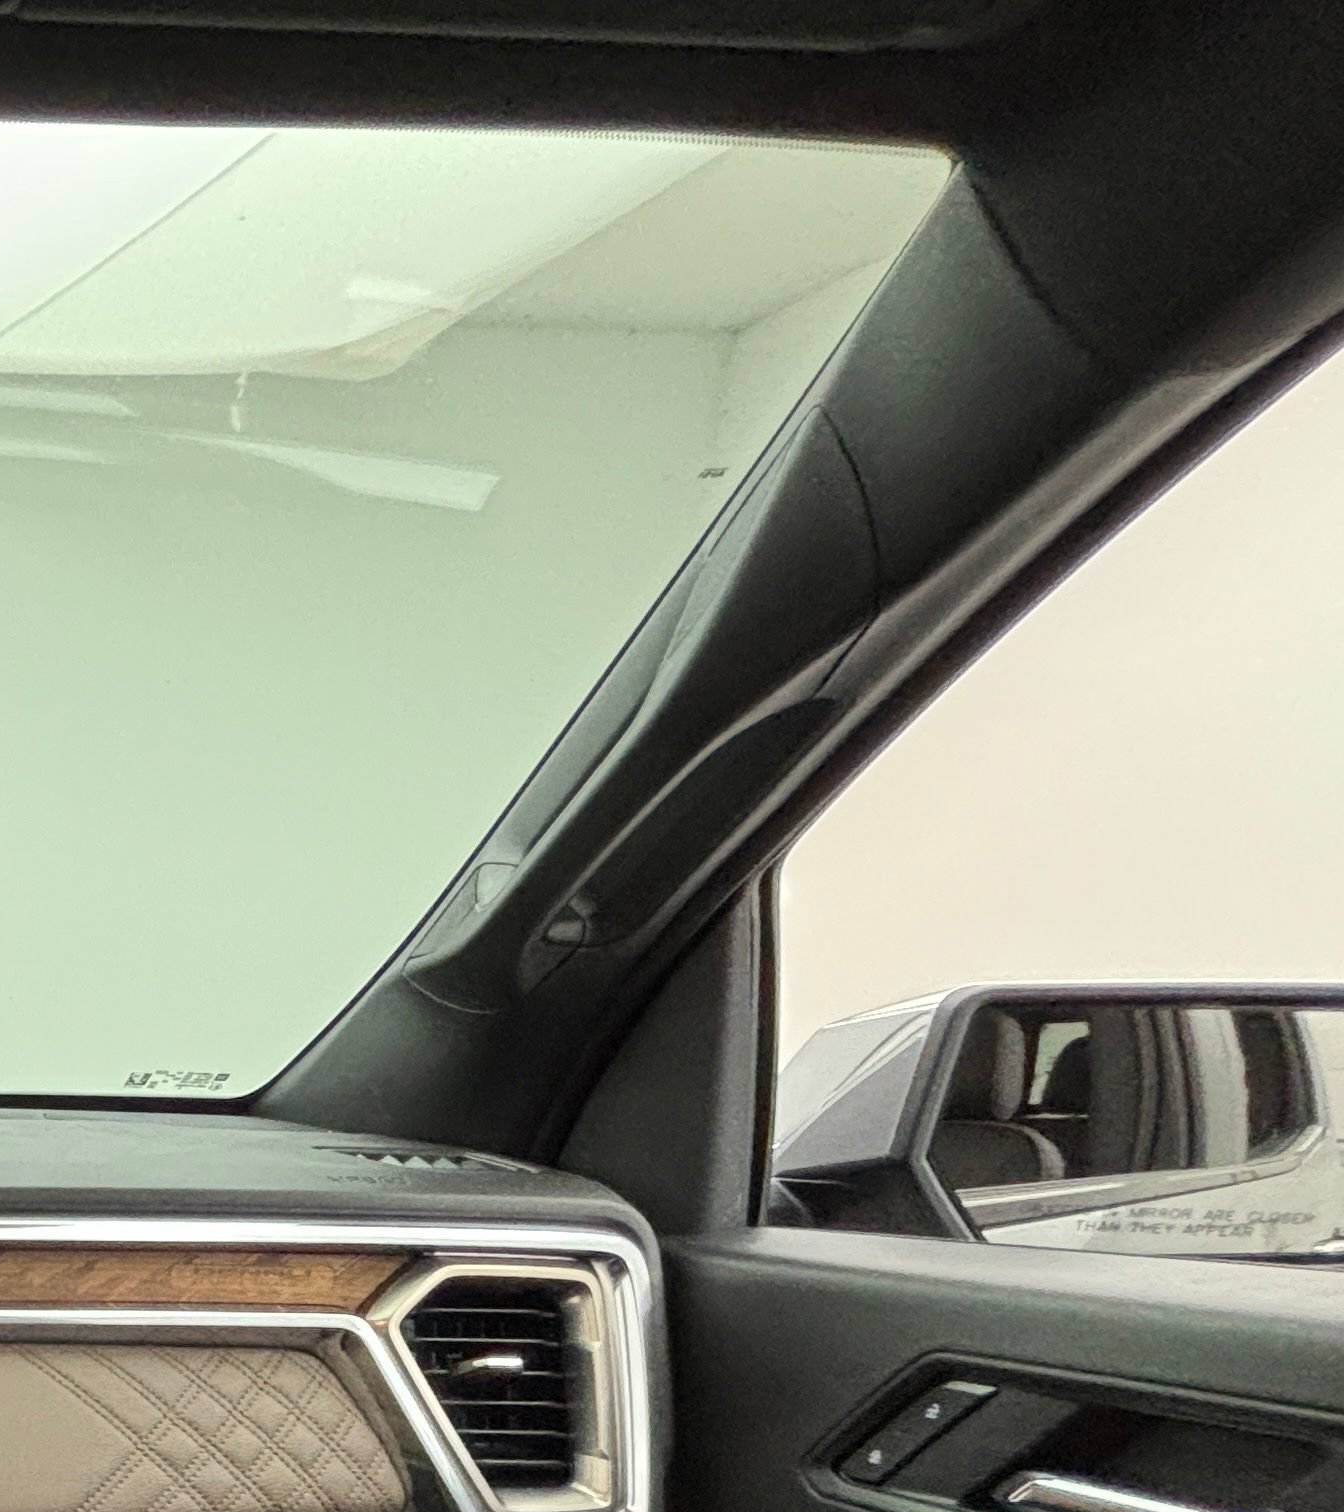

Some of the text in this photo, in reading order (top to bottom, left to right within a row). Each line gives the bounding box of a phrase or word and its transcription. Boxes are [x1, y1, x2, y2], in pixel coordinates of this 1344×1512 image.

[1203, 1209, 1236, 1222] ARE
[1076, 1219, 1121, 1232] THAN
[1182, 1223, 1254, 1237] APPEAR
